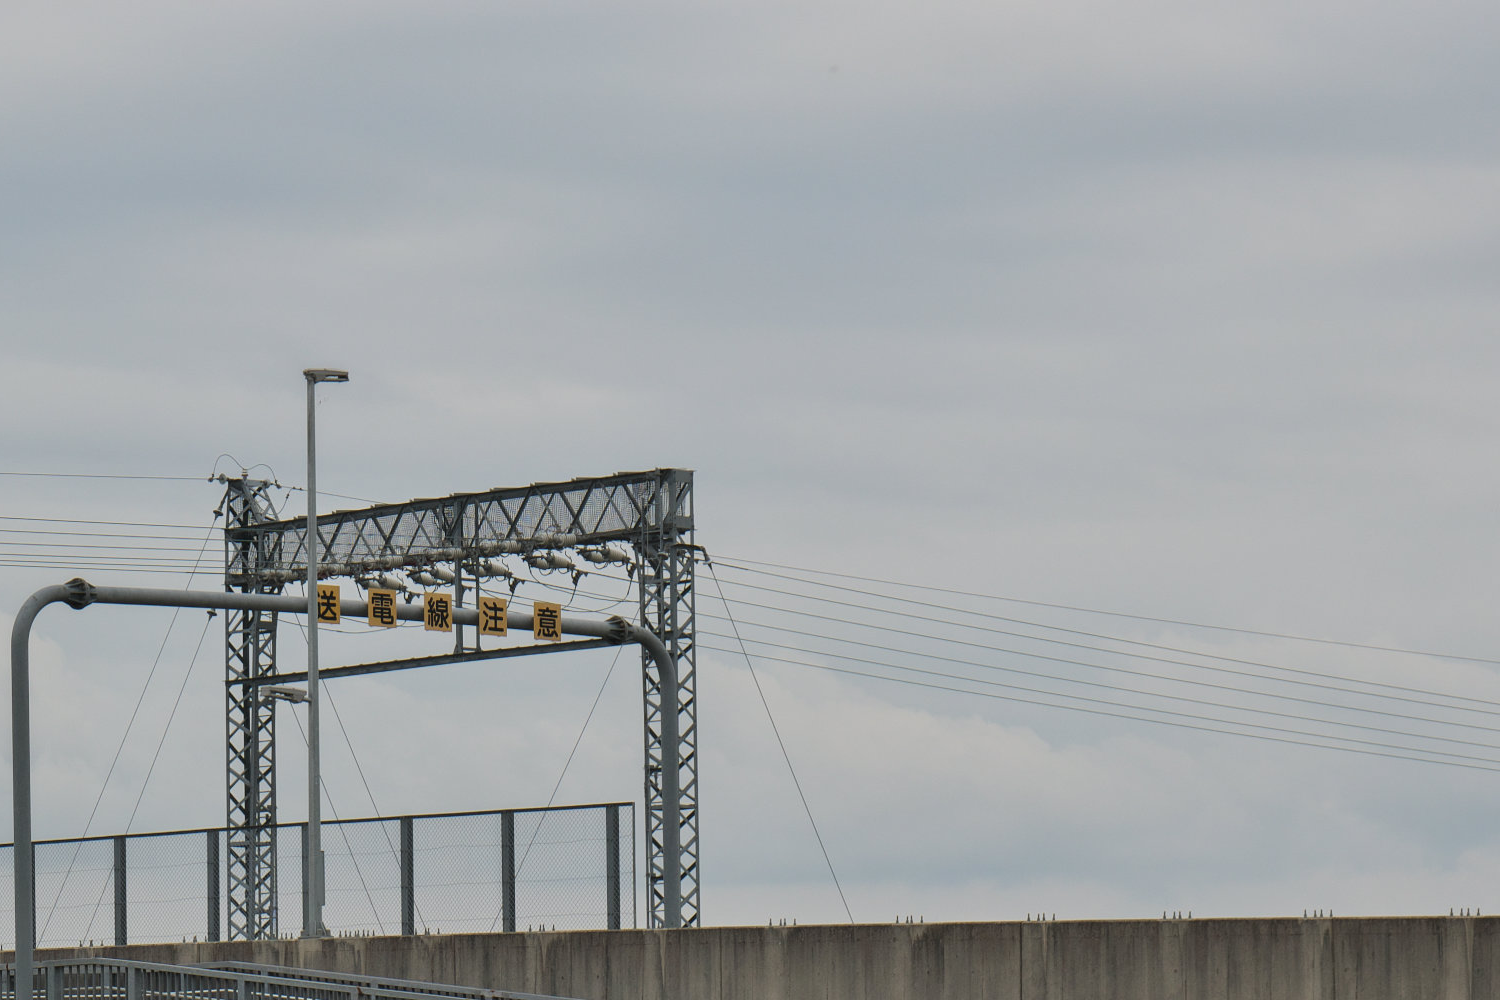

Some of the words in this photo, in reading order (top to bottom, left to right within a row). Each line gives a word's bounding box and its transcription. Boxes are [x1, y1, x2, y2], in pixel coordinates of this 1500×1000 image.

[317, 590, 558, 638] 送電線注意
